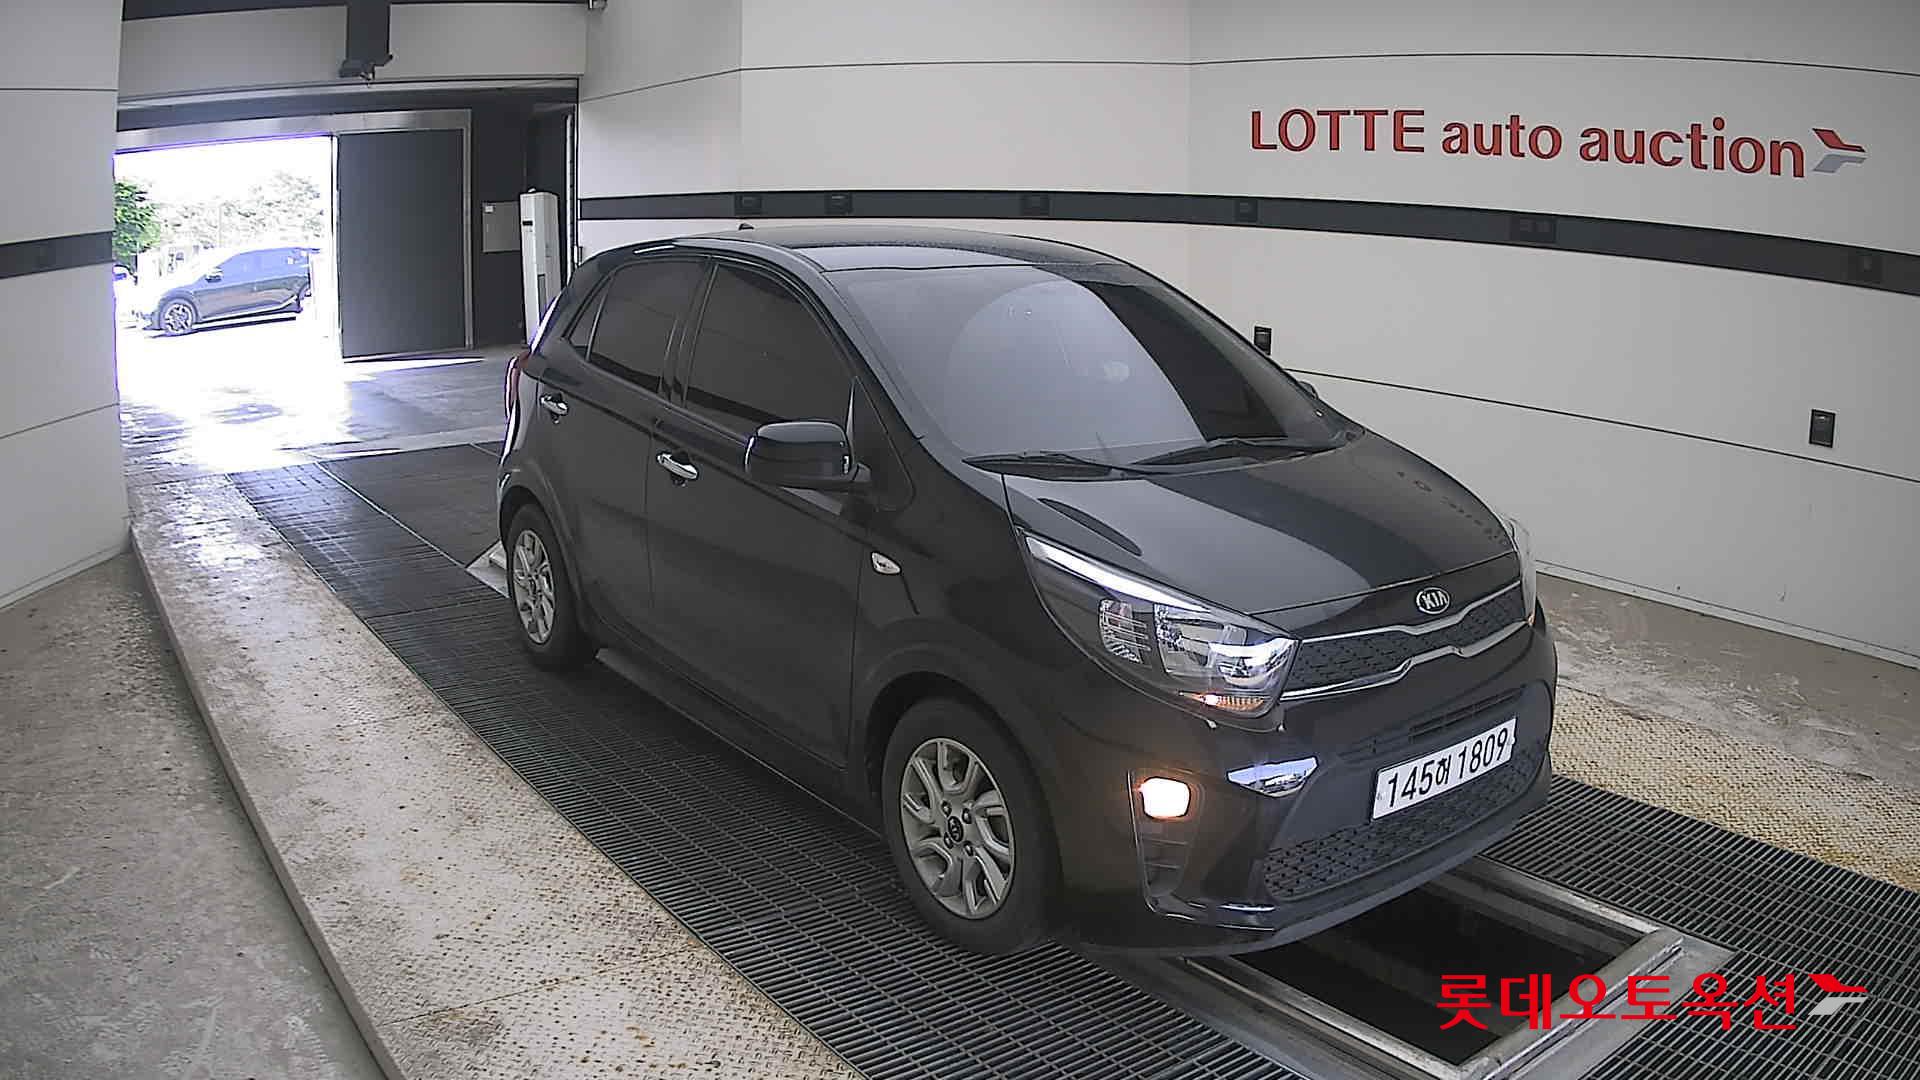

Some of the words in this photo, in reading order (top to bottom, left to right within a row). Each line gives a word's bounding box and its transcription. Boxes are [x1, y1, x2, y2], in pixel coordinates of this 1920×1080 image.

[1251, 109, 1425, 153] LOTTE
[1441, 115, 1563, 160] auto
[1578, 117, 1805, 178] auction
[1420, 590, 1449, 610] KIA
[1387, 754, 1452, 808] 145허
[1458, 727, 1509, 779] 1809
